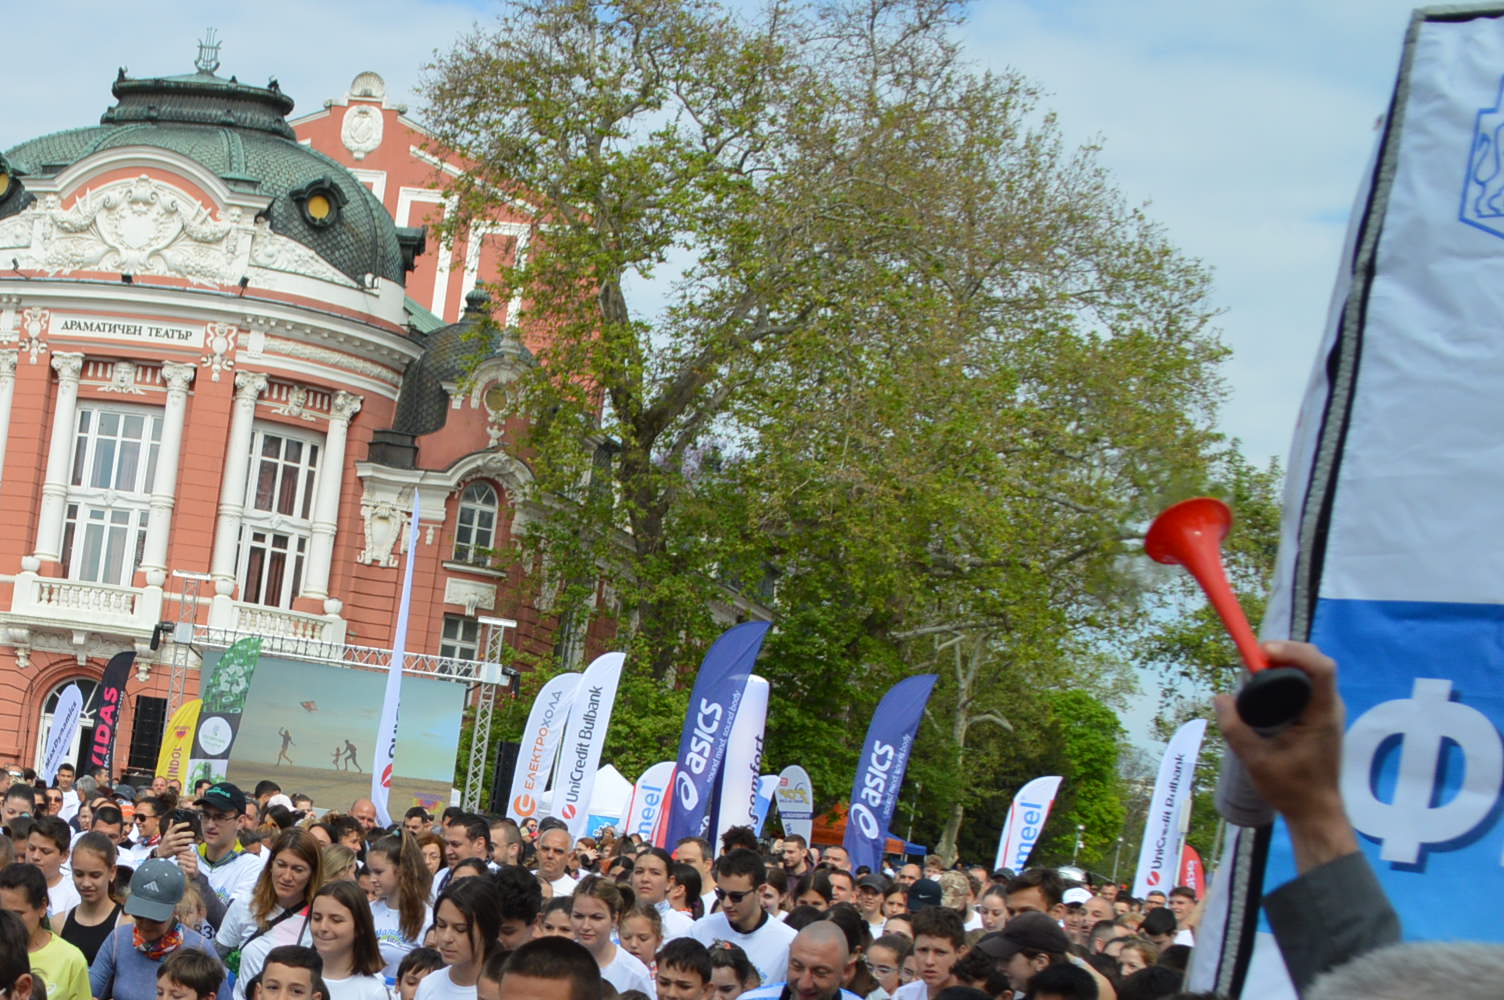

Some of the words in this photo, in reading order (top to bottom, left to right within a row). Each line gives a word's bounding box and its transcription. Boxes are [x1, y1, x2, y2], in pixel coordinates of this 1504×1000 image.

[61, 320, 143, 336] ДРАМАТИЧЕН
[147, 326, 193, 341] ТЕАТЪР
[722, 712, 734, 737] sound
[730, 690, 742, 712] body
[566, 741, 590, 803] UniCredit
[578, 685, 604, 741] Bulbank
